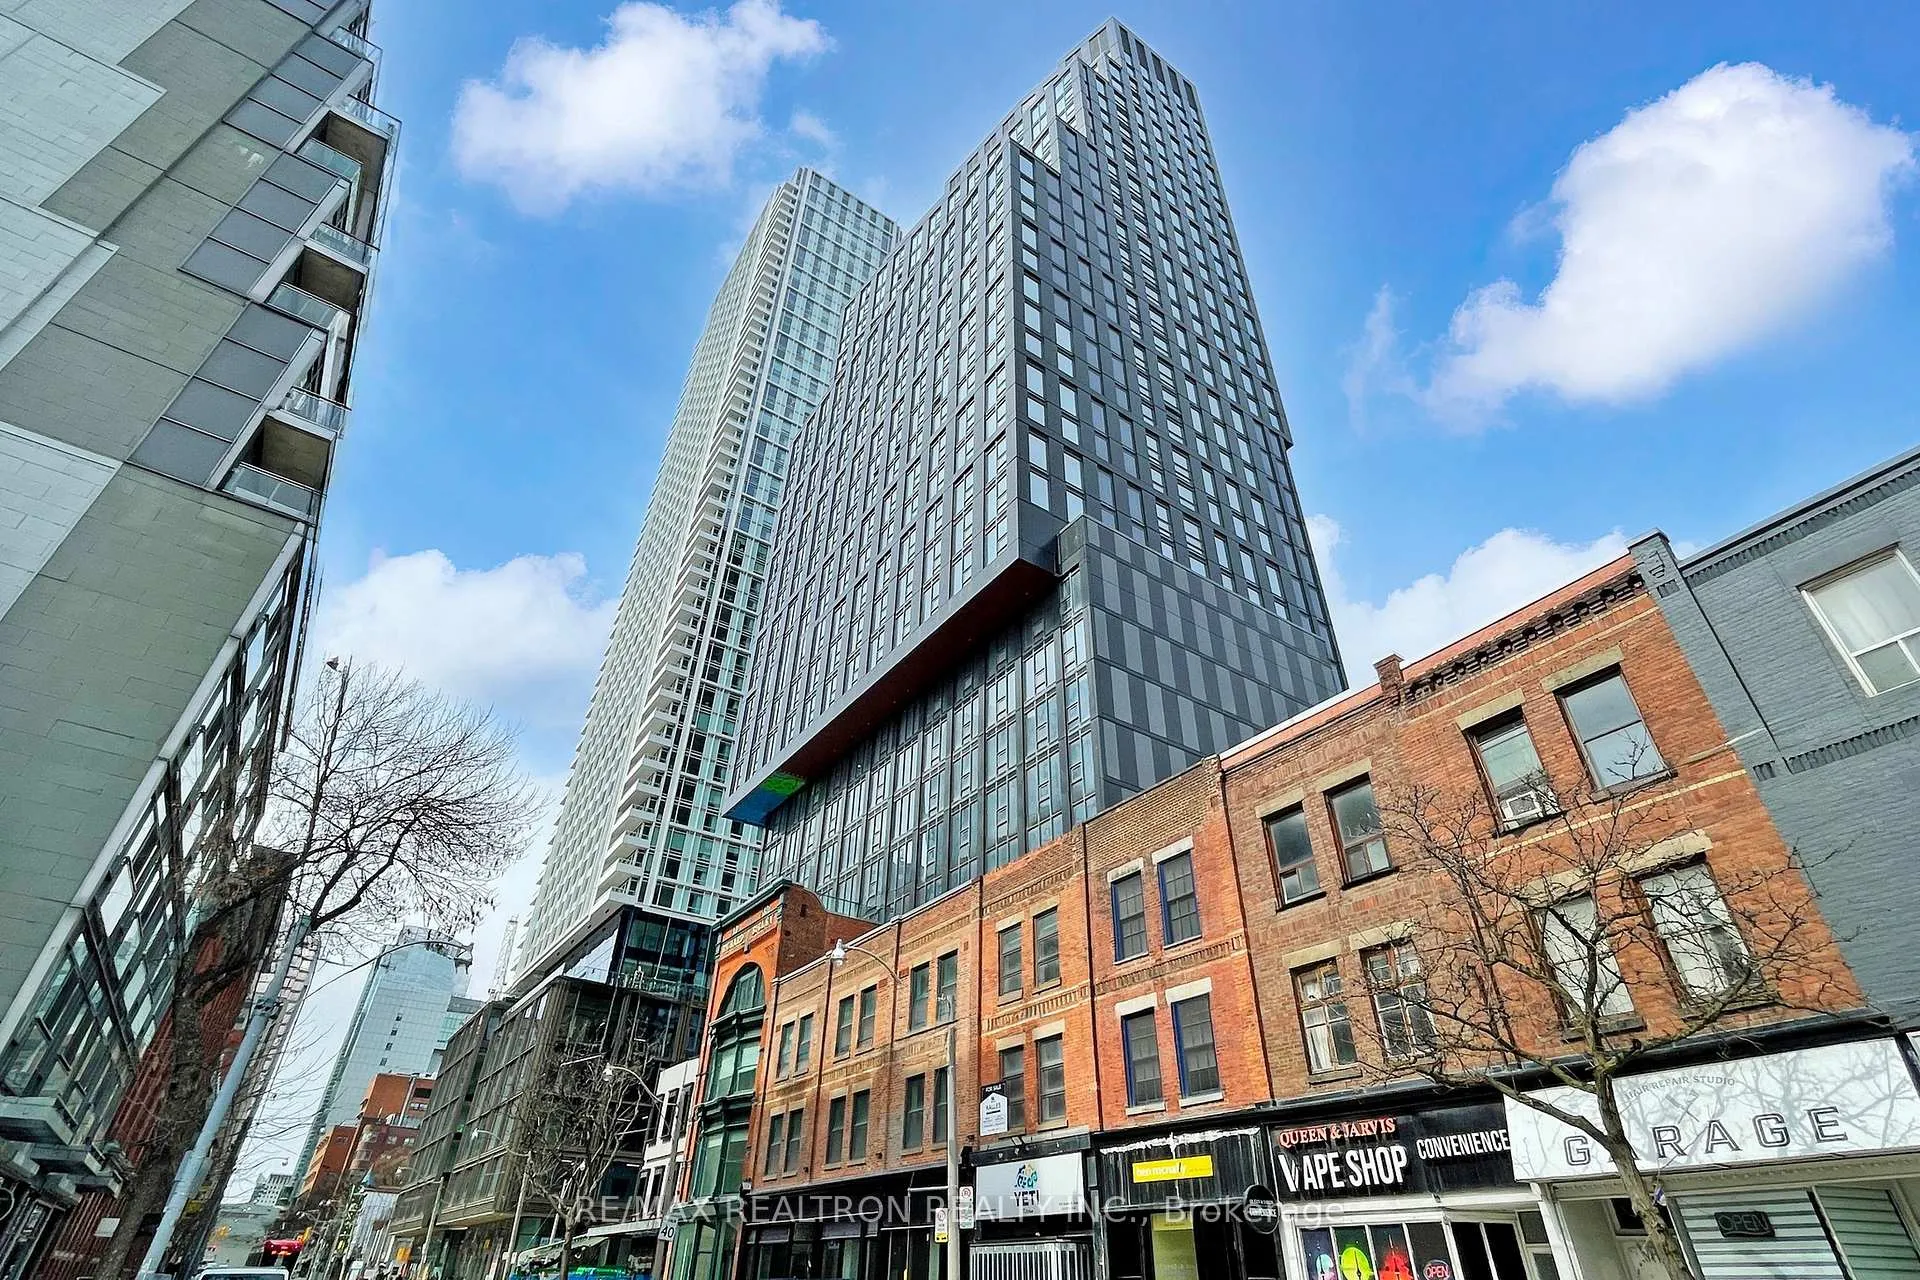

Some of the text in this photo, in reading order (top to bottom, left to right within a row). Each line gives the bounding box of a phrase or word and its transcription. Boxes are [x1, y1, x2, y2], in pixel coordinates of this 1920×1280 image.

[1624, 1075, 1736, 1101] HAIR REPAIR STUDIO
[1279, 1117, 1396, 1148] QUEEN & JARVIS
[1416, 1129, 1511, 1160] CONVENIENCE
[1563, 1105, 1848, 1167] GRAGE
[1278, 1144, 1408, 1193] VAPE SHOP
[1013, 1189, 1040, 1207] YETI
[660, 1225, 675, 1238] 40
[1718, 1214, 1769, 1232] OPEN
[1425, 1265, 1450, 1280] OPEN
